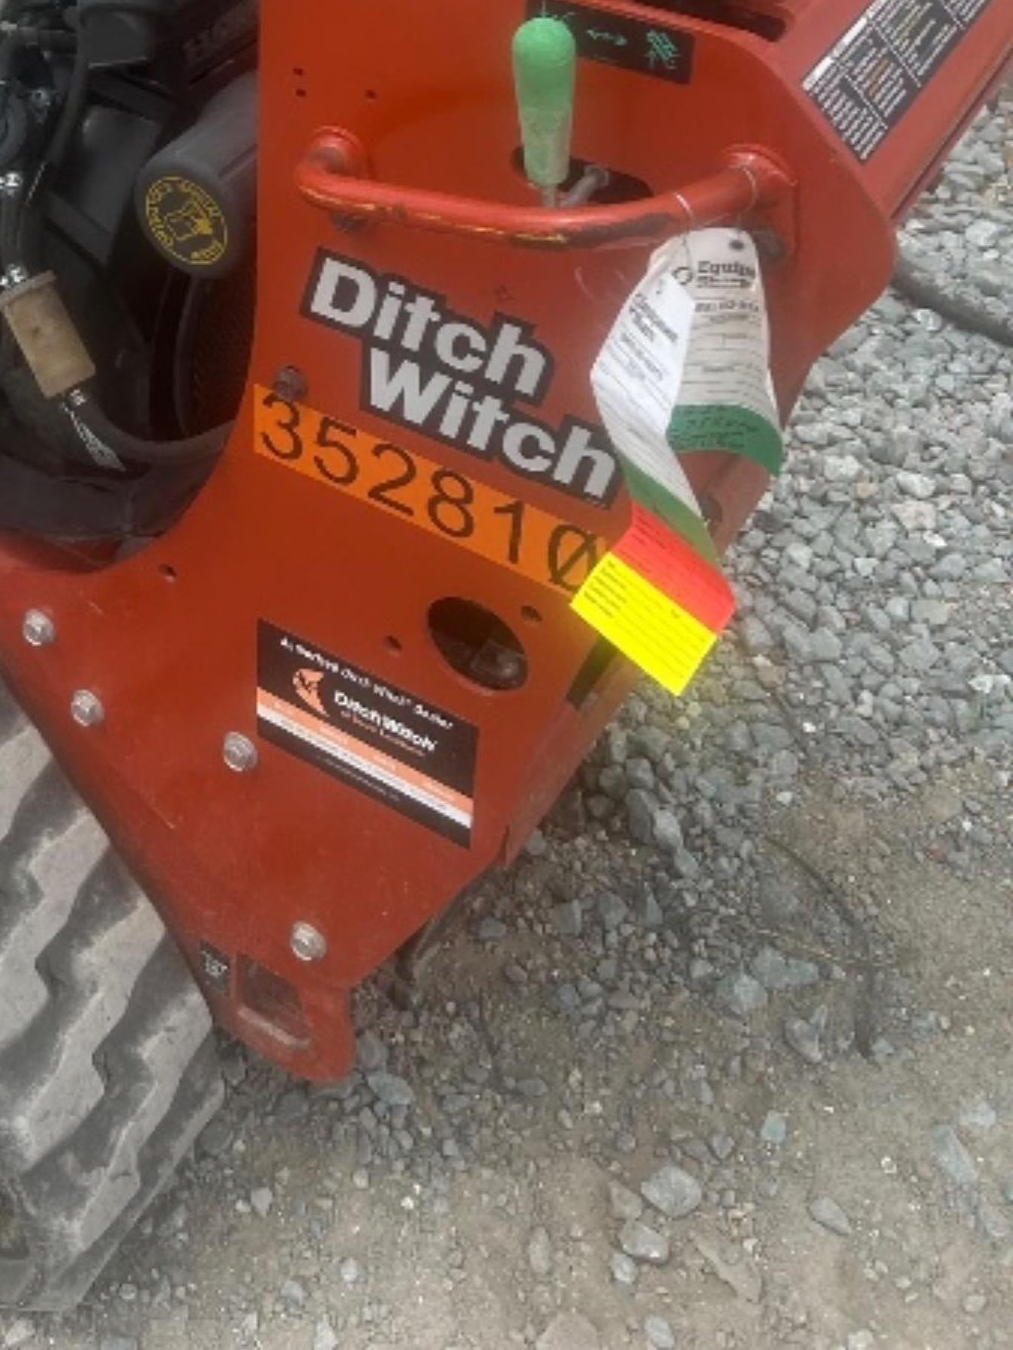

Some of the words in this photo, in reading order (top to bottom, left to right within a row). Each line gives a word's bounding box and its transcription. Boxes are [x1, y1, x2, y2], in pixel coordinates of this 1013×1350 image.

[309, 255, 548, 399] Ditch
[259, 392, 615, 593] 352810
[368, 347, 618, 500] Witch
